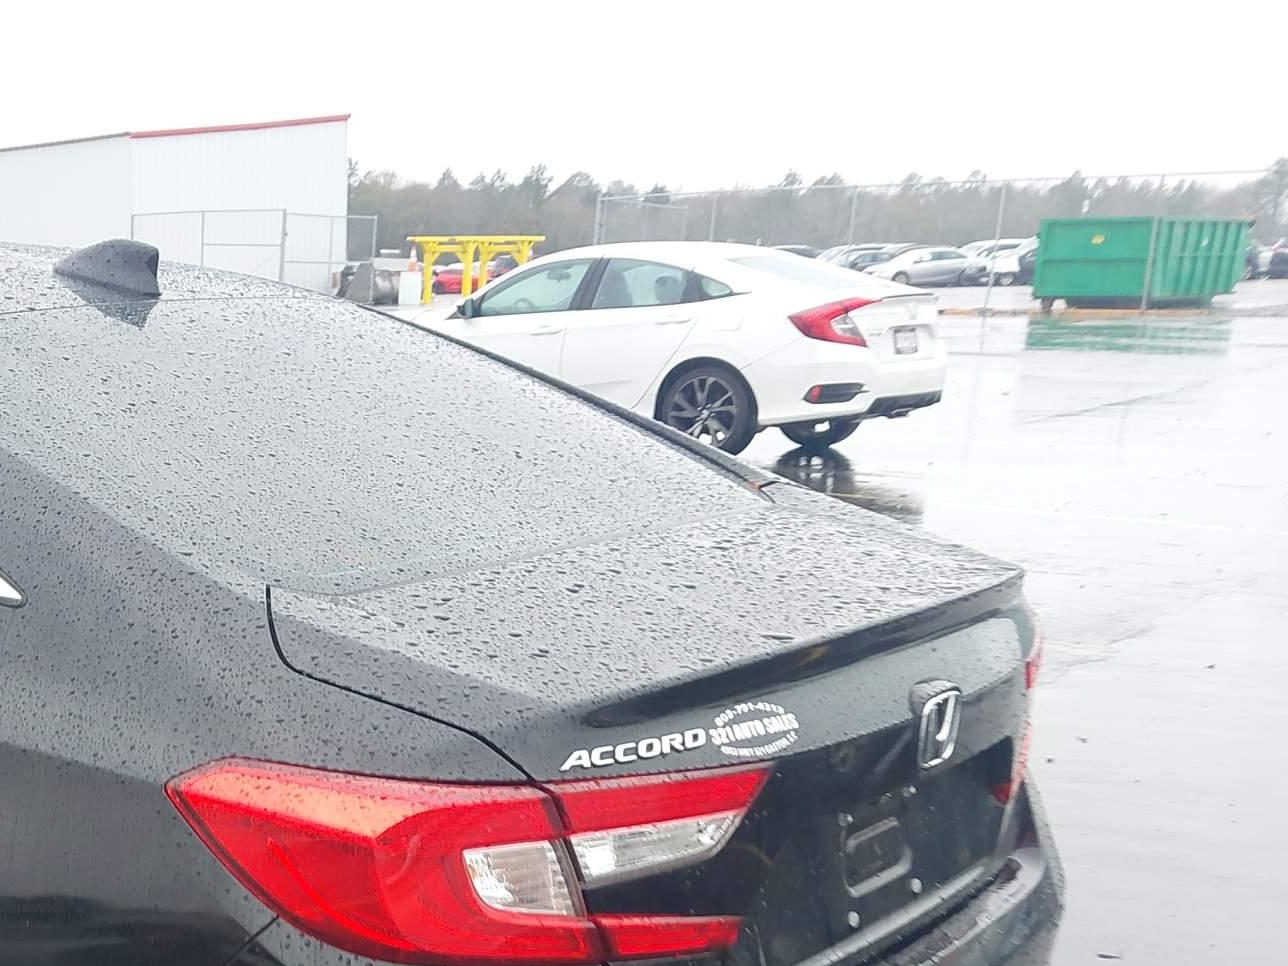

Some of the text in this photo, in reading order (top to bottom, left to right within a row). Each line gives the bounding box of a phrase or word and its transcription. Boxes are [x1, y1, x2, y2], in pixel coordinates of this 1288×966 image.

[708, 725, 736, 746] 321
[732, 719, 766, 741] AUTO
[762, 712, 800, 734] SALES
[559, 727, 708, 772] ACCORD
